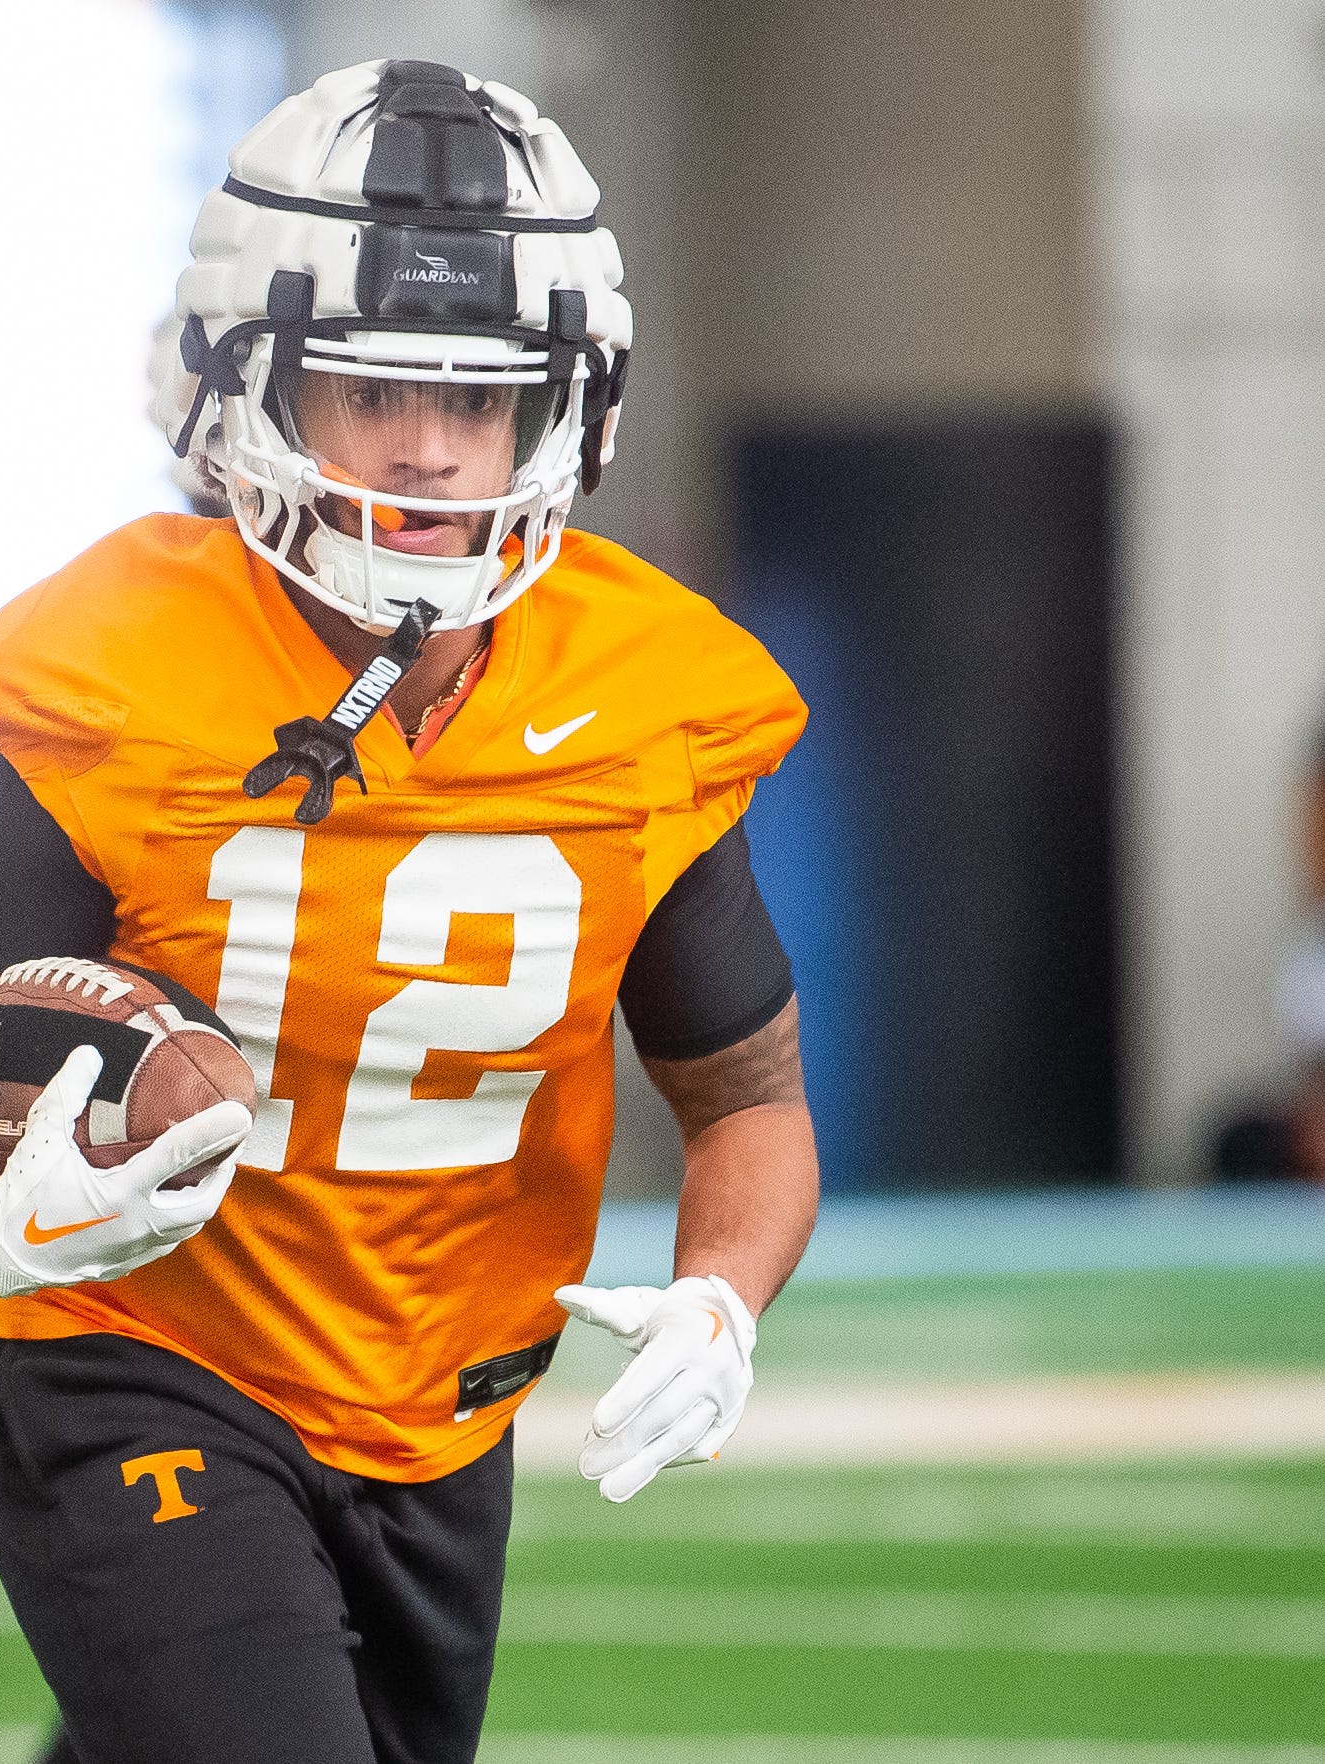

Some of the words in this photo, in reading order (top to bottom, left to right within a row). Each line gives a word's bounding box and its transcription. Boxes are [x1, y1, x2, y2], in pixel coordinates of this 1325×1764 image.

[393, 268, 480, 285] GUARDIAN
[331, 655, 403, 730] NXTRND
[206, 825, 583, 1172] 12
[121, 1449, 206, 1524] T
